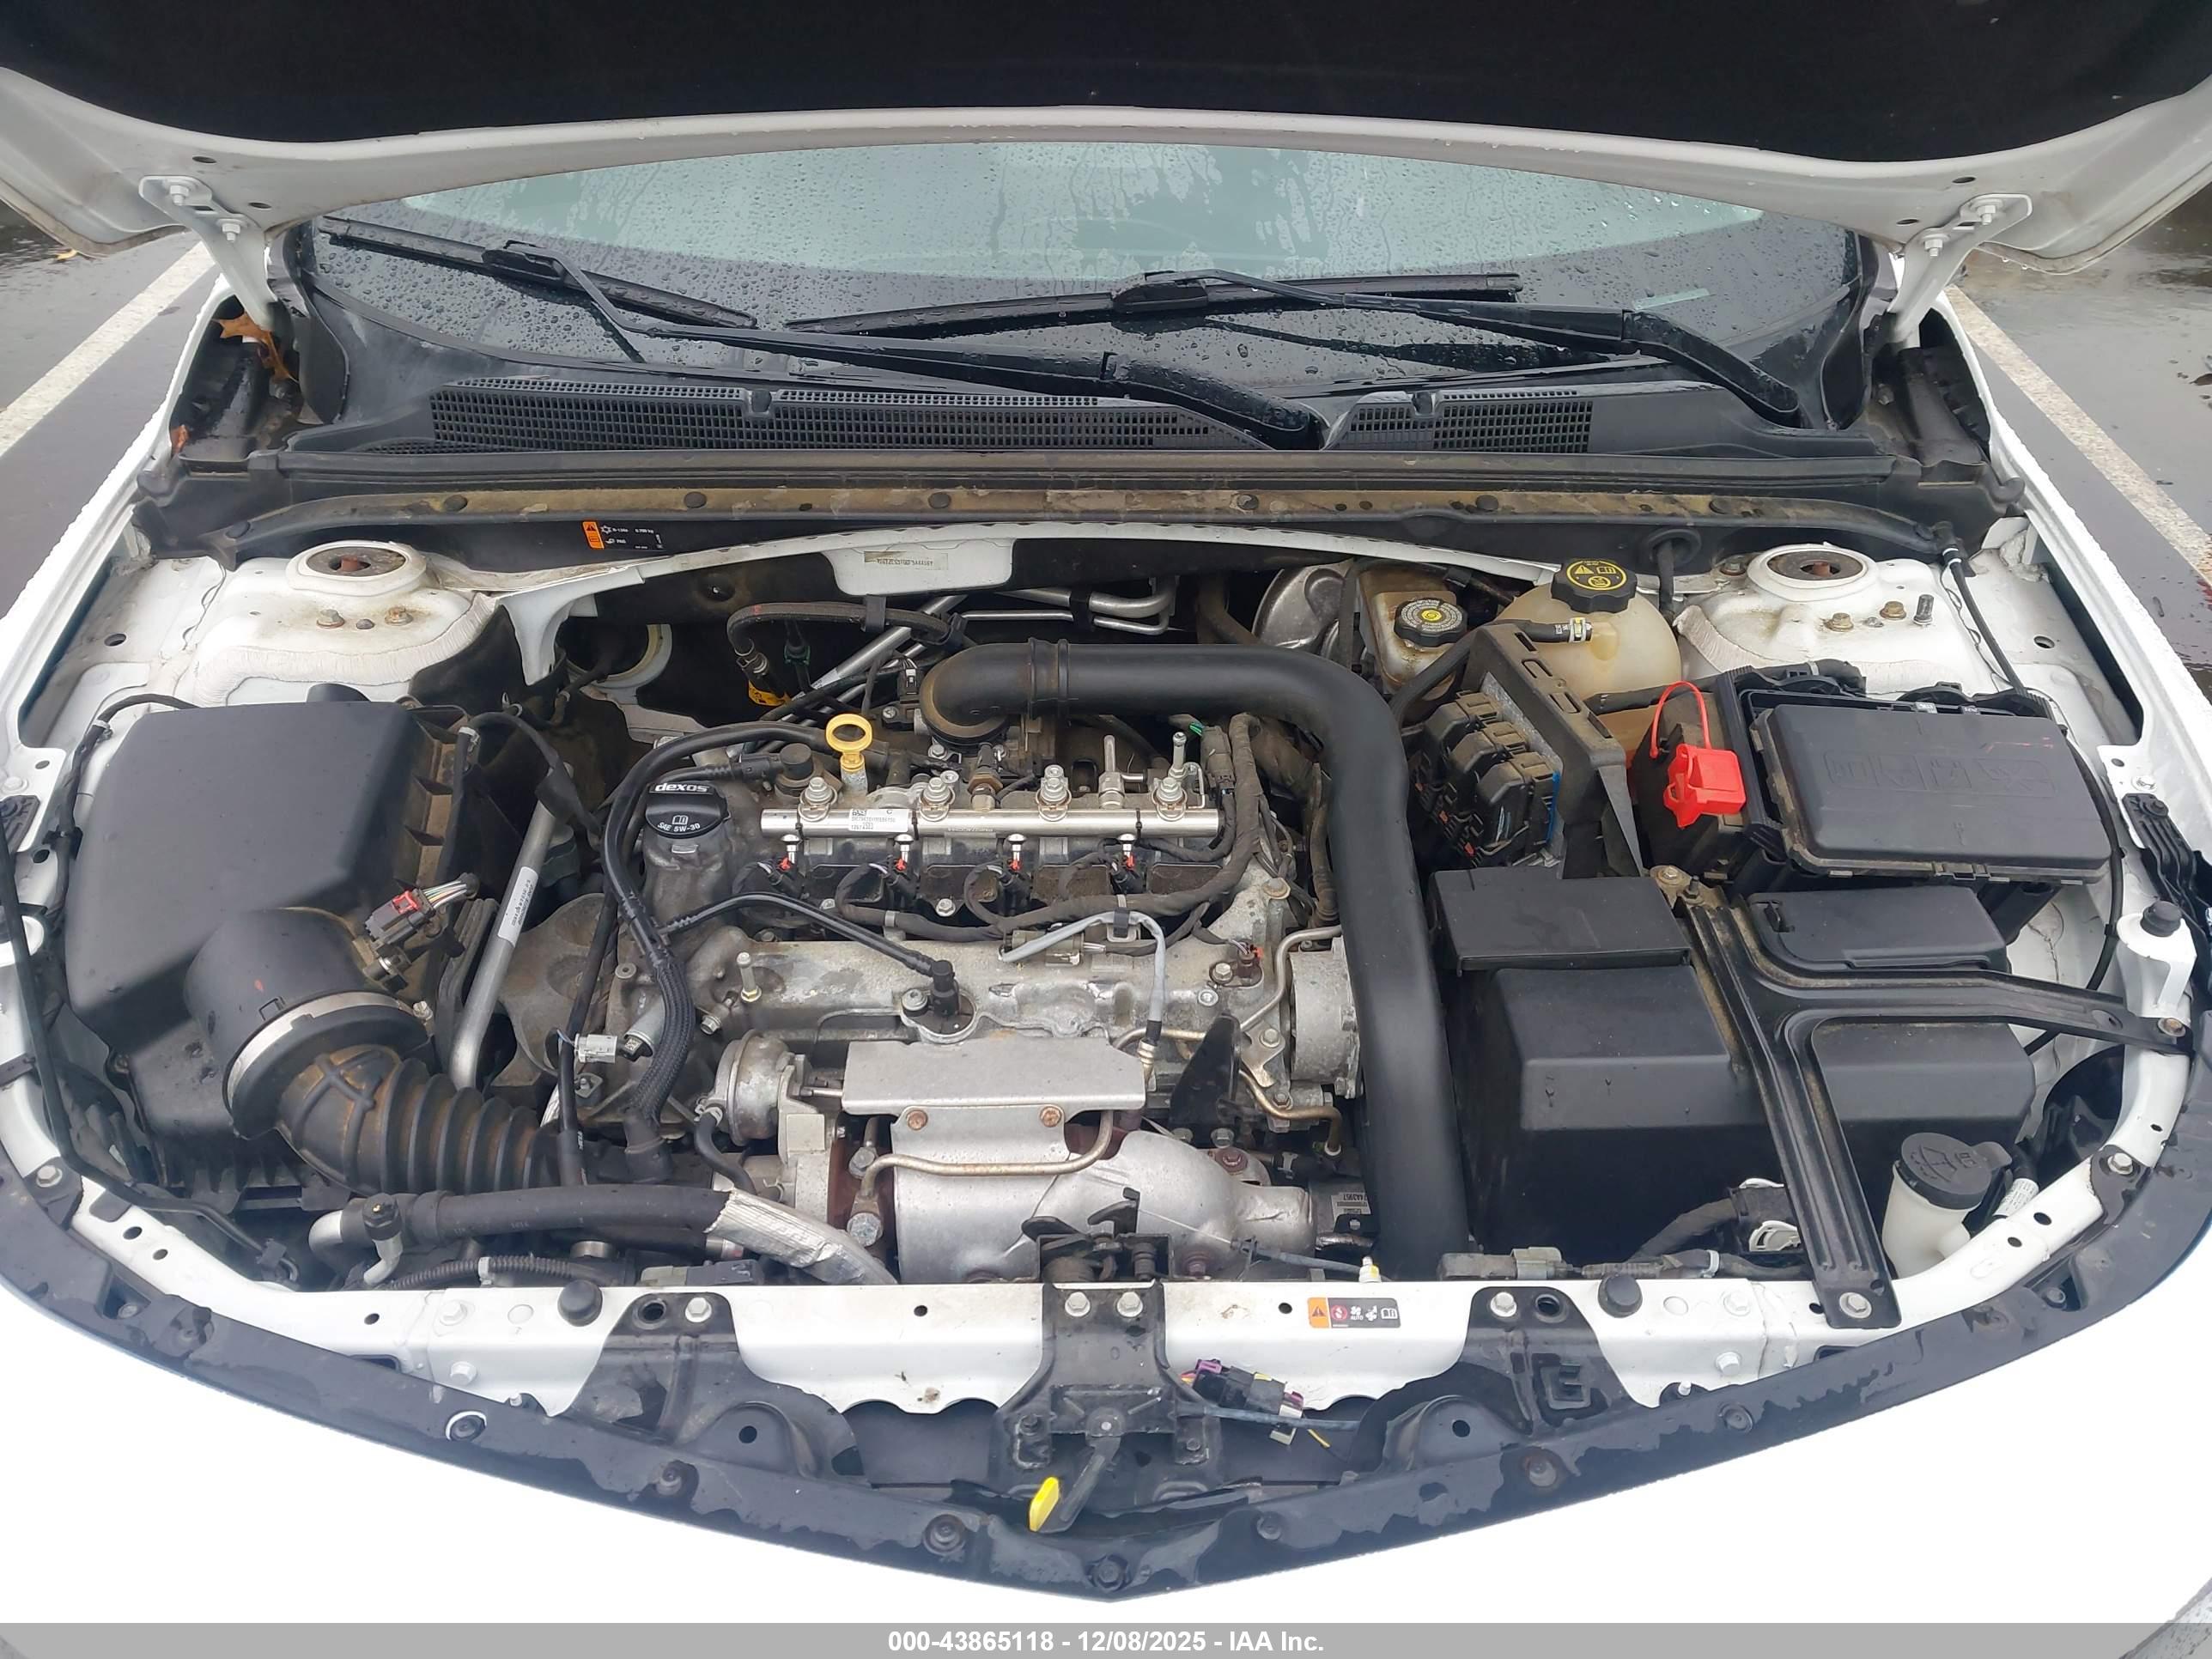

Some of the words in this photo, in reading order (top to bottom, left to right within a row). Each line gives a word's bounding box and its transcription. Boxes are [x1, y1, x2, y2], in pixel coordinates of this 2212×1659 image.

[654, 782, 710, 793] dexos
[657, 822, 672, 831] SAE
[673, 823, 701, 832] 5W-30
